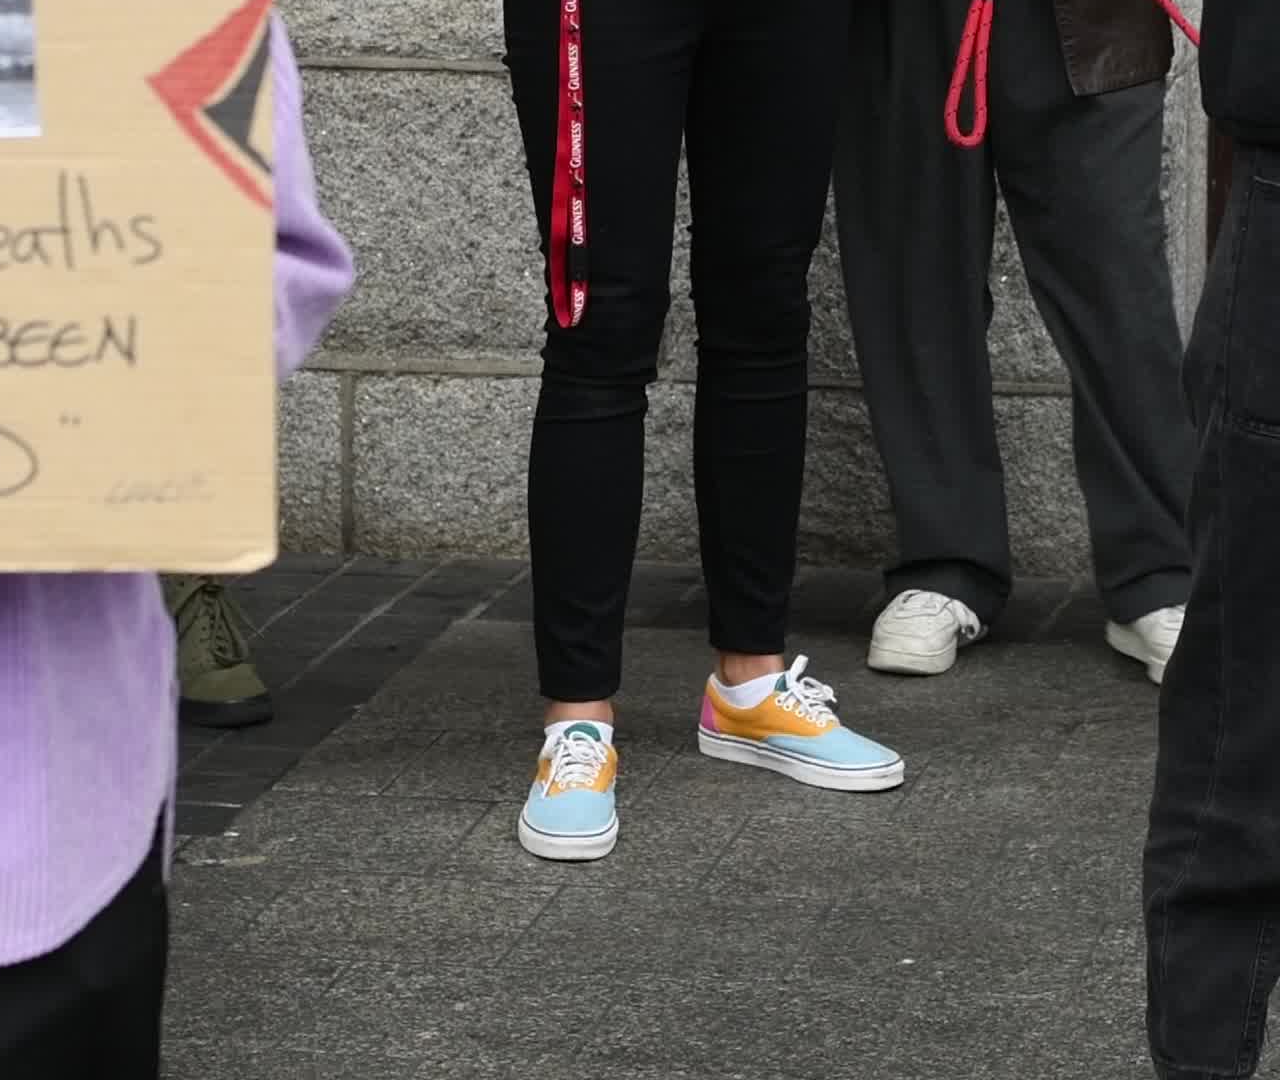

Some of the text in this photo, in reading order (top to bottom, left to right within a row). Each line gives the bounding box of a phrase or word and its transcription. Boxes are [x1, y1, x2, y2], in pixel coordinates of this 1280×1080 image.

[568, 43, 580, 91] GUINNESS
[570, 121, 582, 169] GUINNESS
[572, 197, 584, 246] GUINNESS
